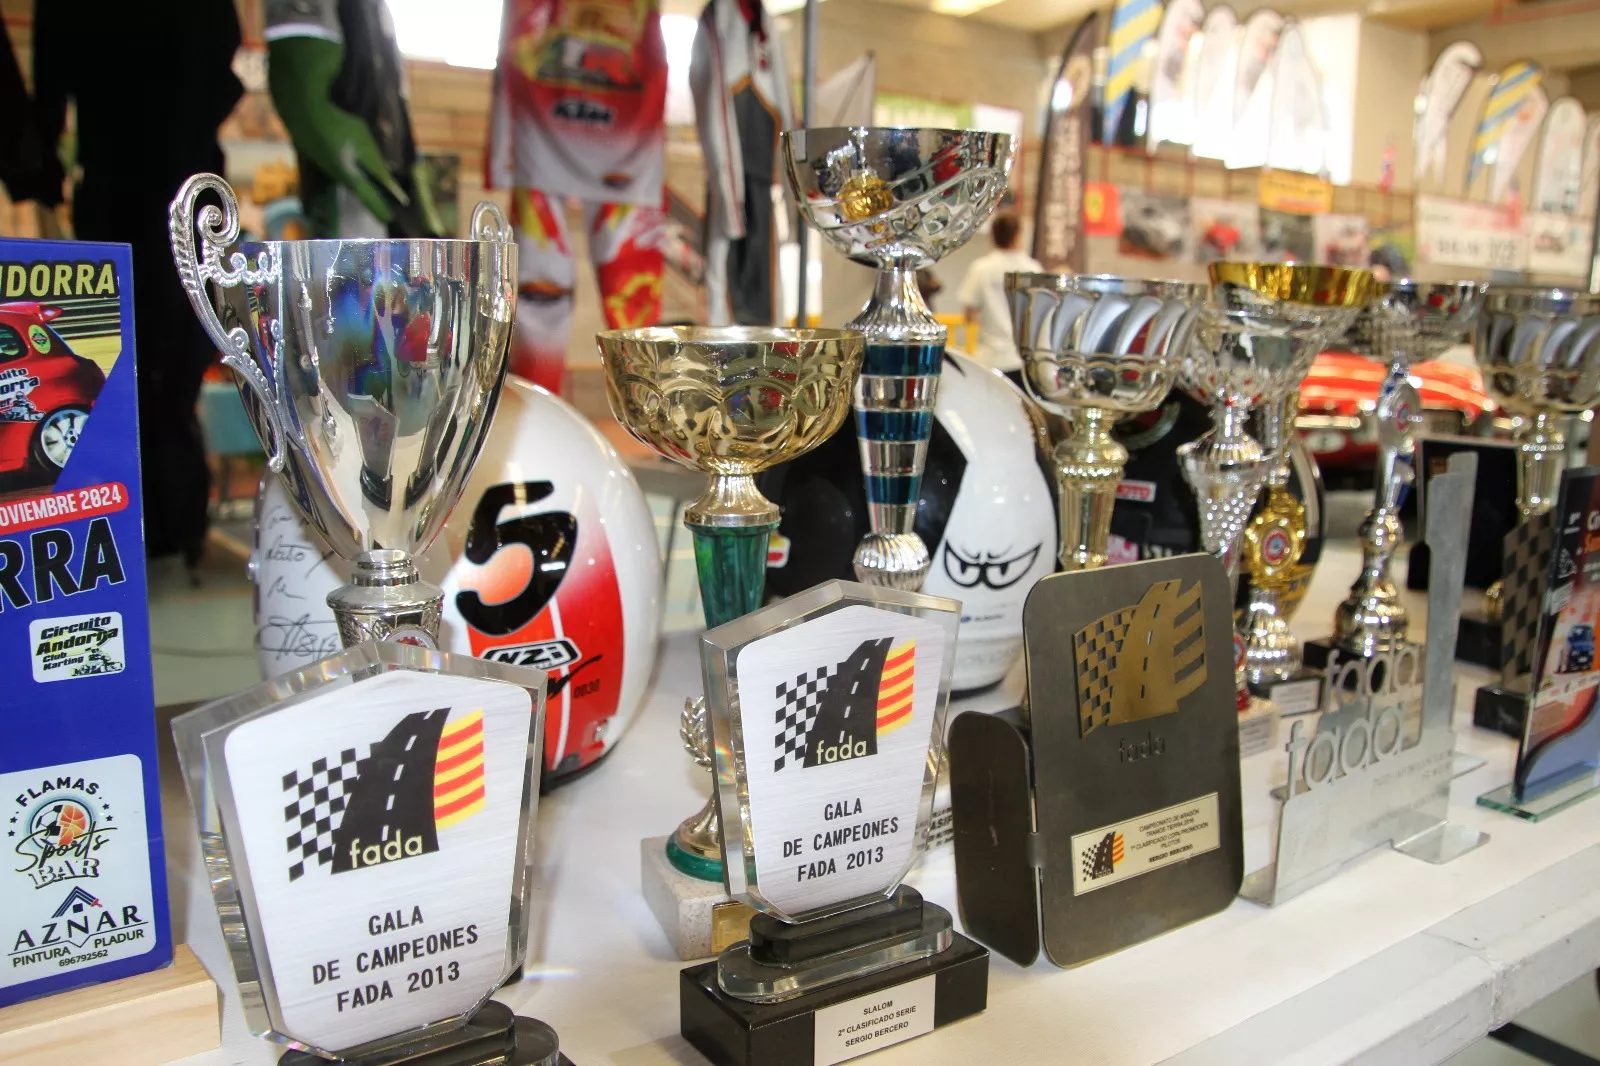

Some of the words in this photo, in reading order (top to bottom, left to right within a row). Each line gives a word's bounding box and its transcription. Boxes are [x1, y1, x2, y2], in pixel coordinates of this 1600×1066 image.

[0, 263, 115, 297] DORRA
[79, 485, 122, 511] 2024
[455, 480, 579, 637] 5
[41, 616, 112, 640] Circuito
[43, 652, 67, 663] Club
[43, 656, 84, 671] Karting
[816, 735, 867, 764] fada
[1118, 731, 1166, 763] fada
[15, 776, 100, 807] FLAMAS
[824, 797, 863, 821] GALA
[15, 820, 118, 873] Sports
[349, 829, 423, 869] fada
[783, 838, 803, 858] DE
[813, 816, 899, 851] CAMPEONES
[797, 858, 837, 882] FADA
[846, 846, 884, 870] 2013
[14, 905, 142, 951] AZNAR
[368, 905, 424, 936] GALA
[13, 946, 71, 968] PINTURA
[94, 928, 144, 949] PLADUR
[59, 949, 108, 967] 696792562
[312, 959, 341, 985] DE
[356, 924, 479, 973] CAMPEONES
[336, 980, 394, 1013] FADA
[406, 961, 460, 993] 2013
[846, 1012, 894, 1034] CLASIFICADO
[895, 1005, 917, 1018] SERIE
[863, 1000, 893, 1015] SLALOM
[845, 1032, 873, 1047] SERGIO
[874, 1021, 909, 1038] BERCERO
